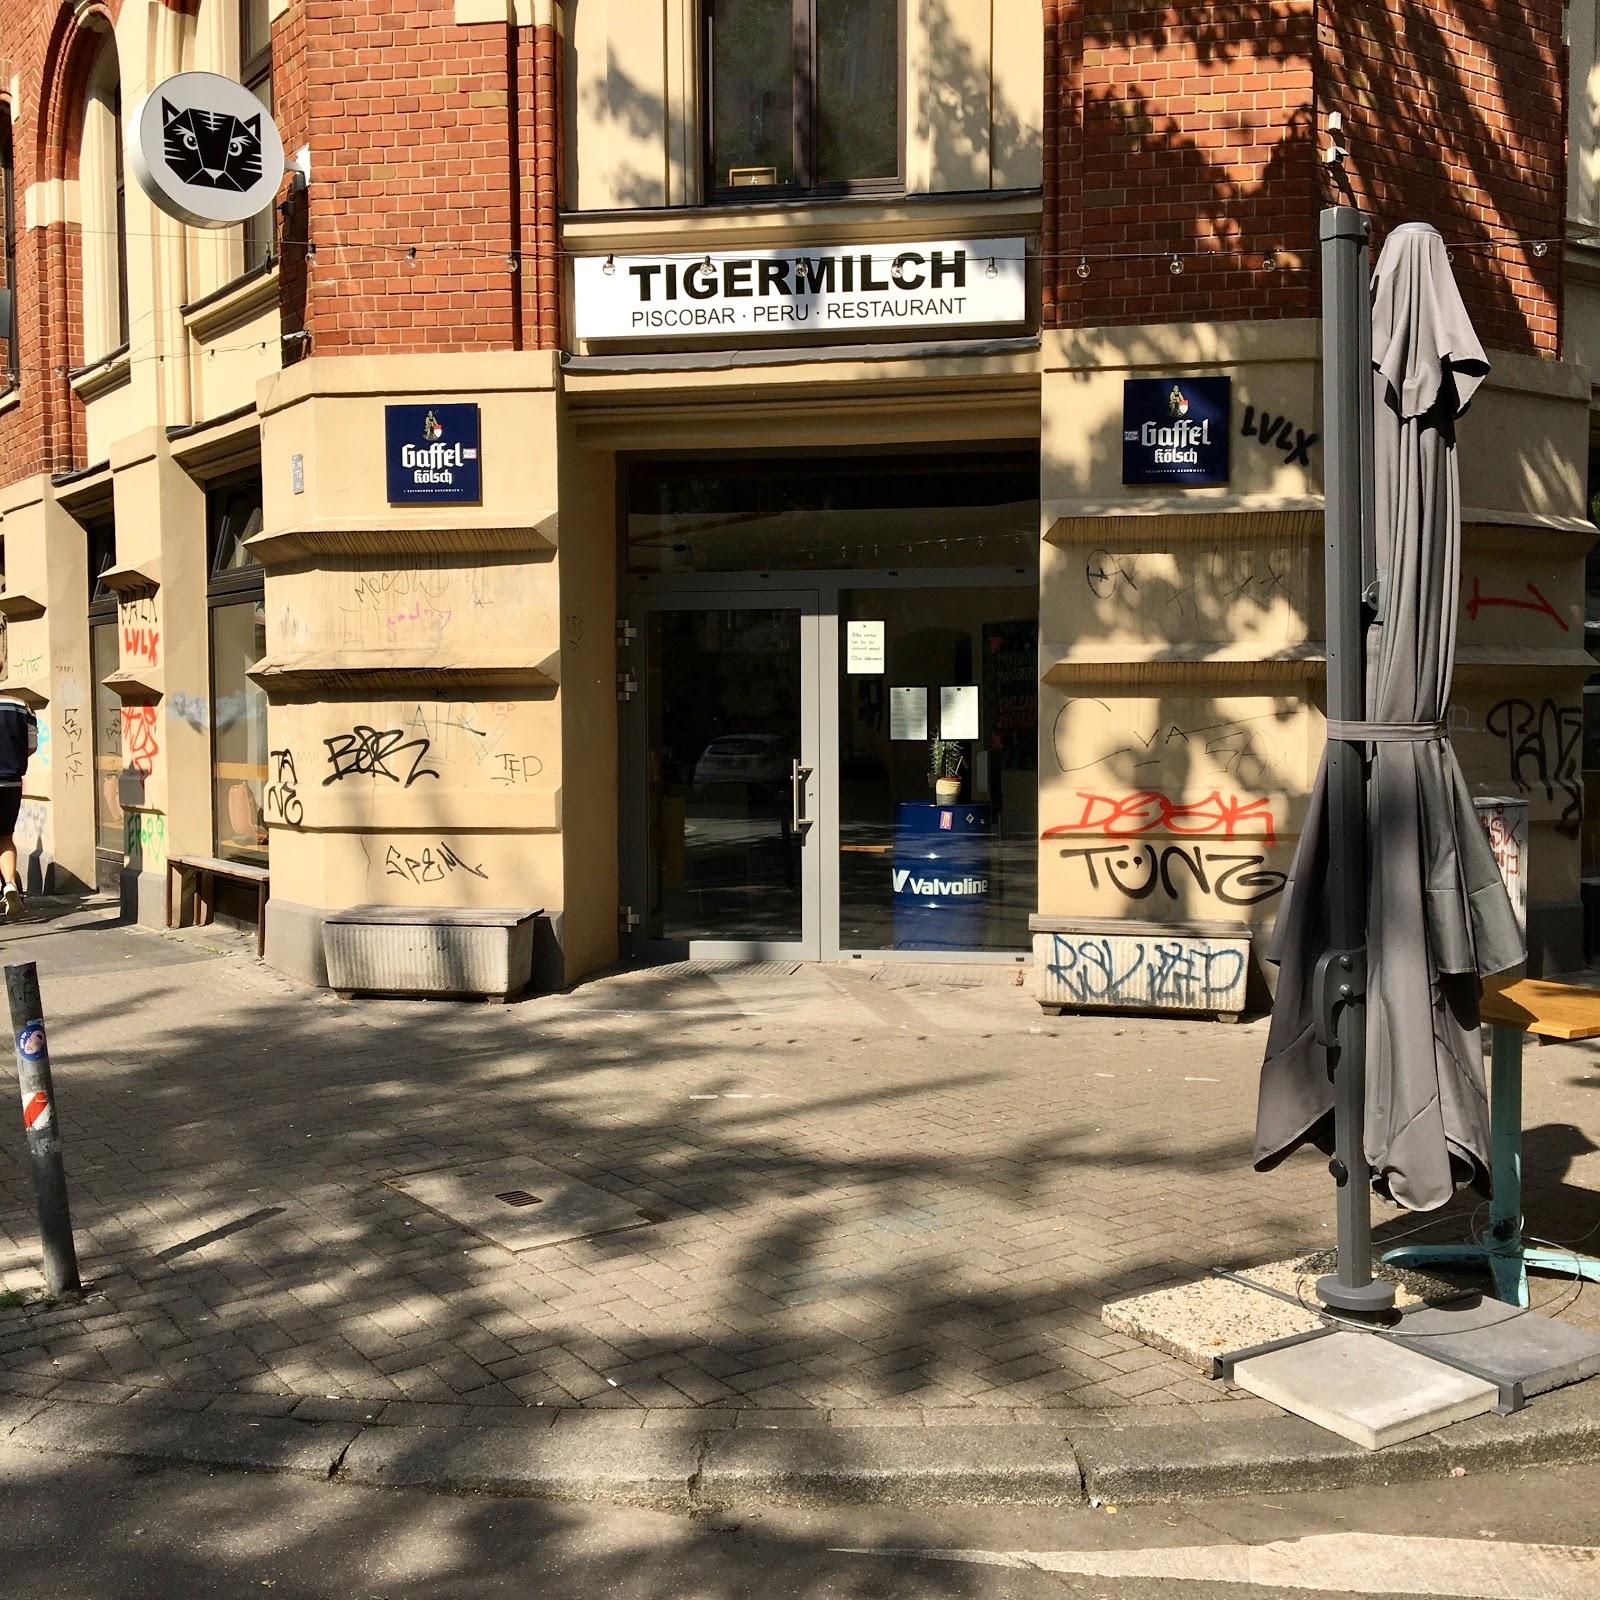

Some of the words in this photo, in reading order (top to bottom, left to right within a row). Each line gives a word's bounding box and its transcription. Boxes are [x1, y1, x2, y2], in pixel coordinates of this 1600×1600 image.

[629, 249, 966, 302] TIGERMILCH
[632, 307, 735, 328] PISCOBAR
[753, 303, 809, 323] PERU
[827, 297, 967, 320] RESTAURANT
[1141, 419, 1212, 449] Gaffel
[402, 442, 464, 470] Gaffel
[909, 877, 989, 896] Valvoline
